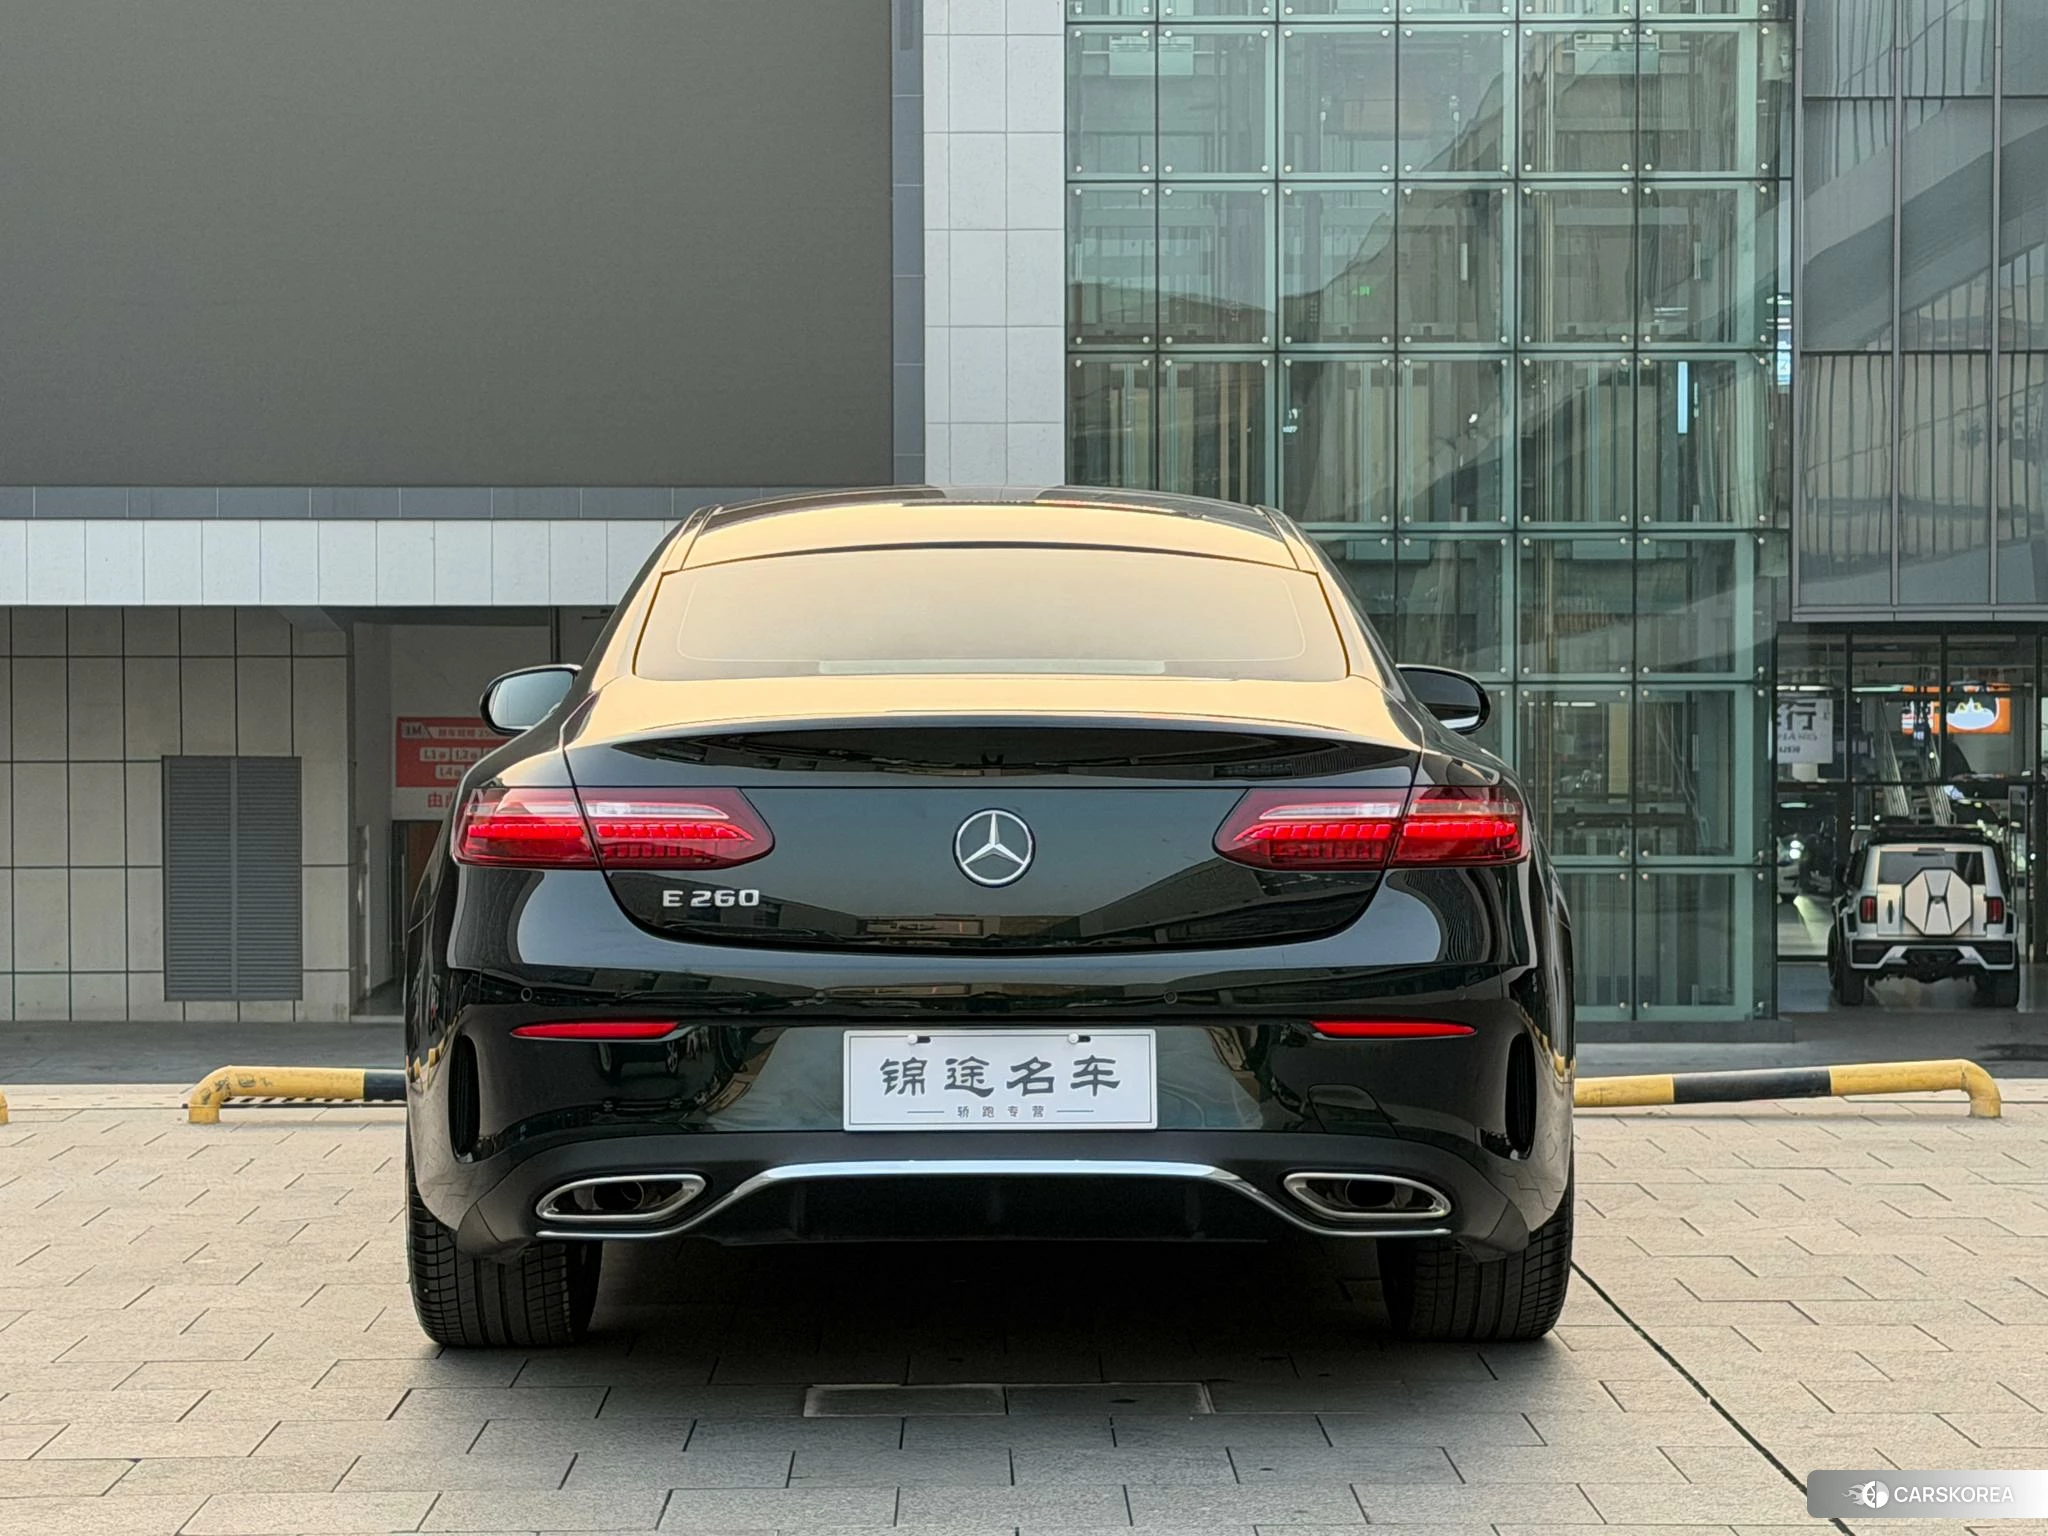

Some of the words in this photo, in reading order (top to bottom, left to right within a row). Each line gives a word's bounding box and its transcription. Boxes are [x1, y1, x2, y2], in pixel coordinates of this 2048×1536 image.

[662, 889, 684, 907] E
[690, 889, 760, 908] 260
[880, 1054, 1121, 1098] 锦途名车
[957, 1105, 1044, 1118] 轿跑专营
